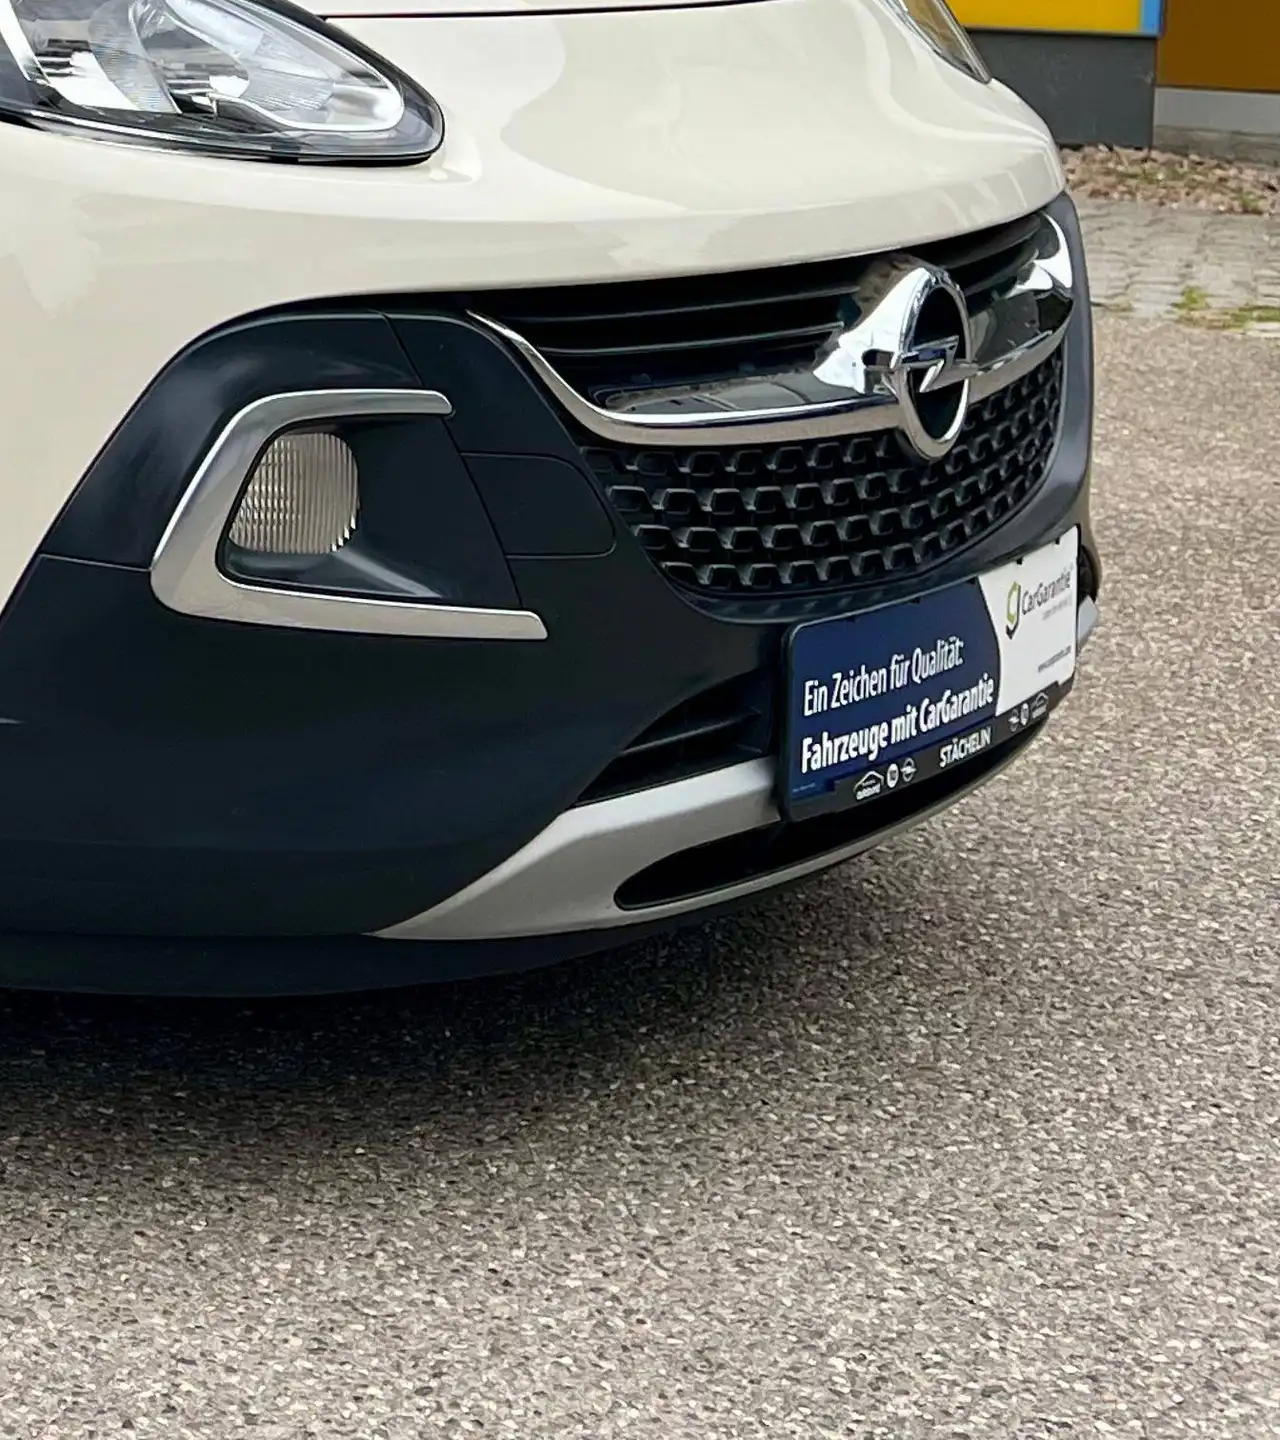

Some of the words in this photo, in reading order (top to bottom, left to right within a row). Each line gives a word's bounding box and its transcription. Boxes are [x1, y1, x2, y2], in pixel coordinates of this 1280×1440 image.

[804, 679, 828, 717] Ein
[831, 664, 887, 709] Zeichen
[890, 653, 911, 691] für
[911, 635, 965, 685] Qualität:
[801, 721, 889, 774] Fahrzeuge
[890, 703, 919, 745] mit
[919, 672, 996, 733] CarGarantie
[939, 726, 992, 769] STÄCHELIN
